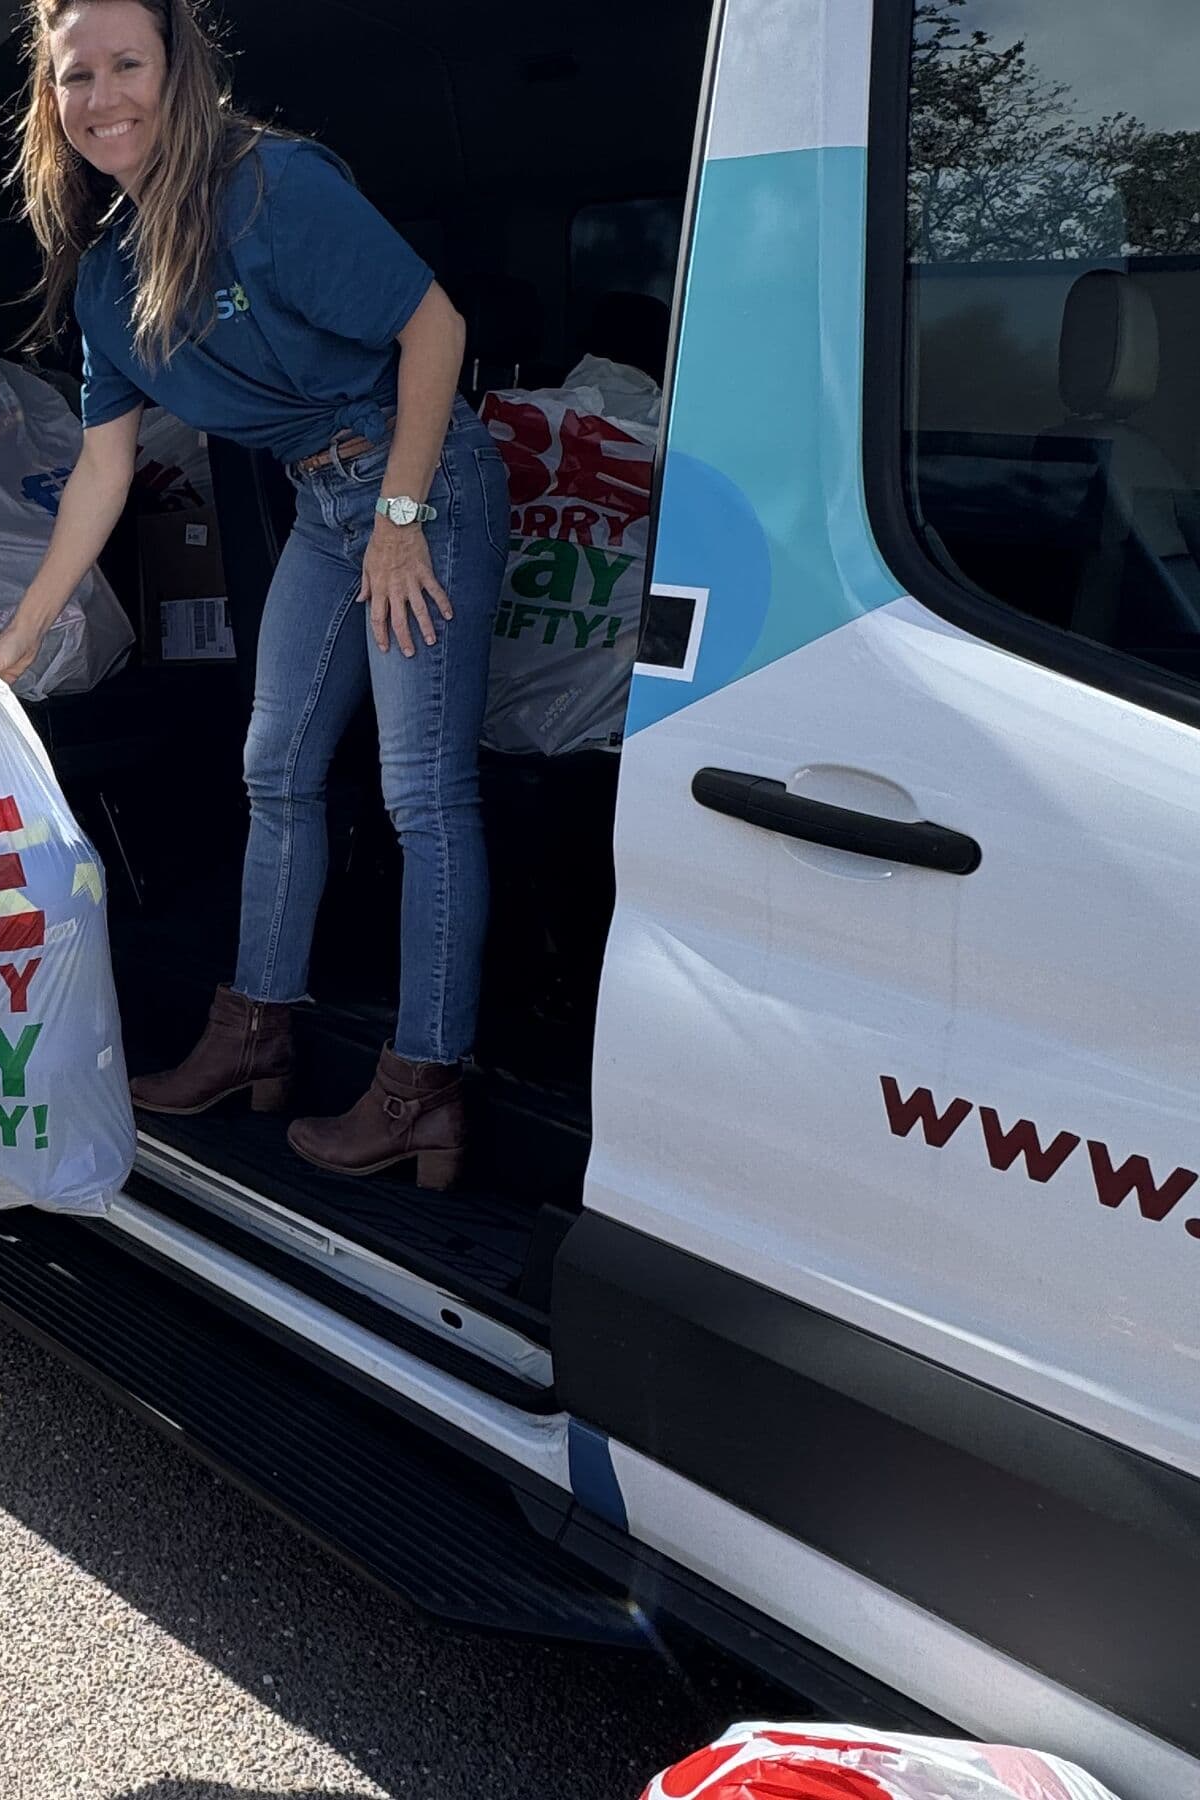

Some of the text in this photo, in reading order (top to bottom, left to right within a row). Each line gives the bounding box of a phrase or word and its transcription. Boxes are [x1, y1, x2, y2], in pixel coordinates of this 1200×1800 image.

[481, 391, 652, 517] BE
[510, 504, 634, 547] RRY
[509, 538, 638, 607] aY
[494, 600, 622, 649] iFTY!
[879, 1075, 1200, 1240] www.
